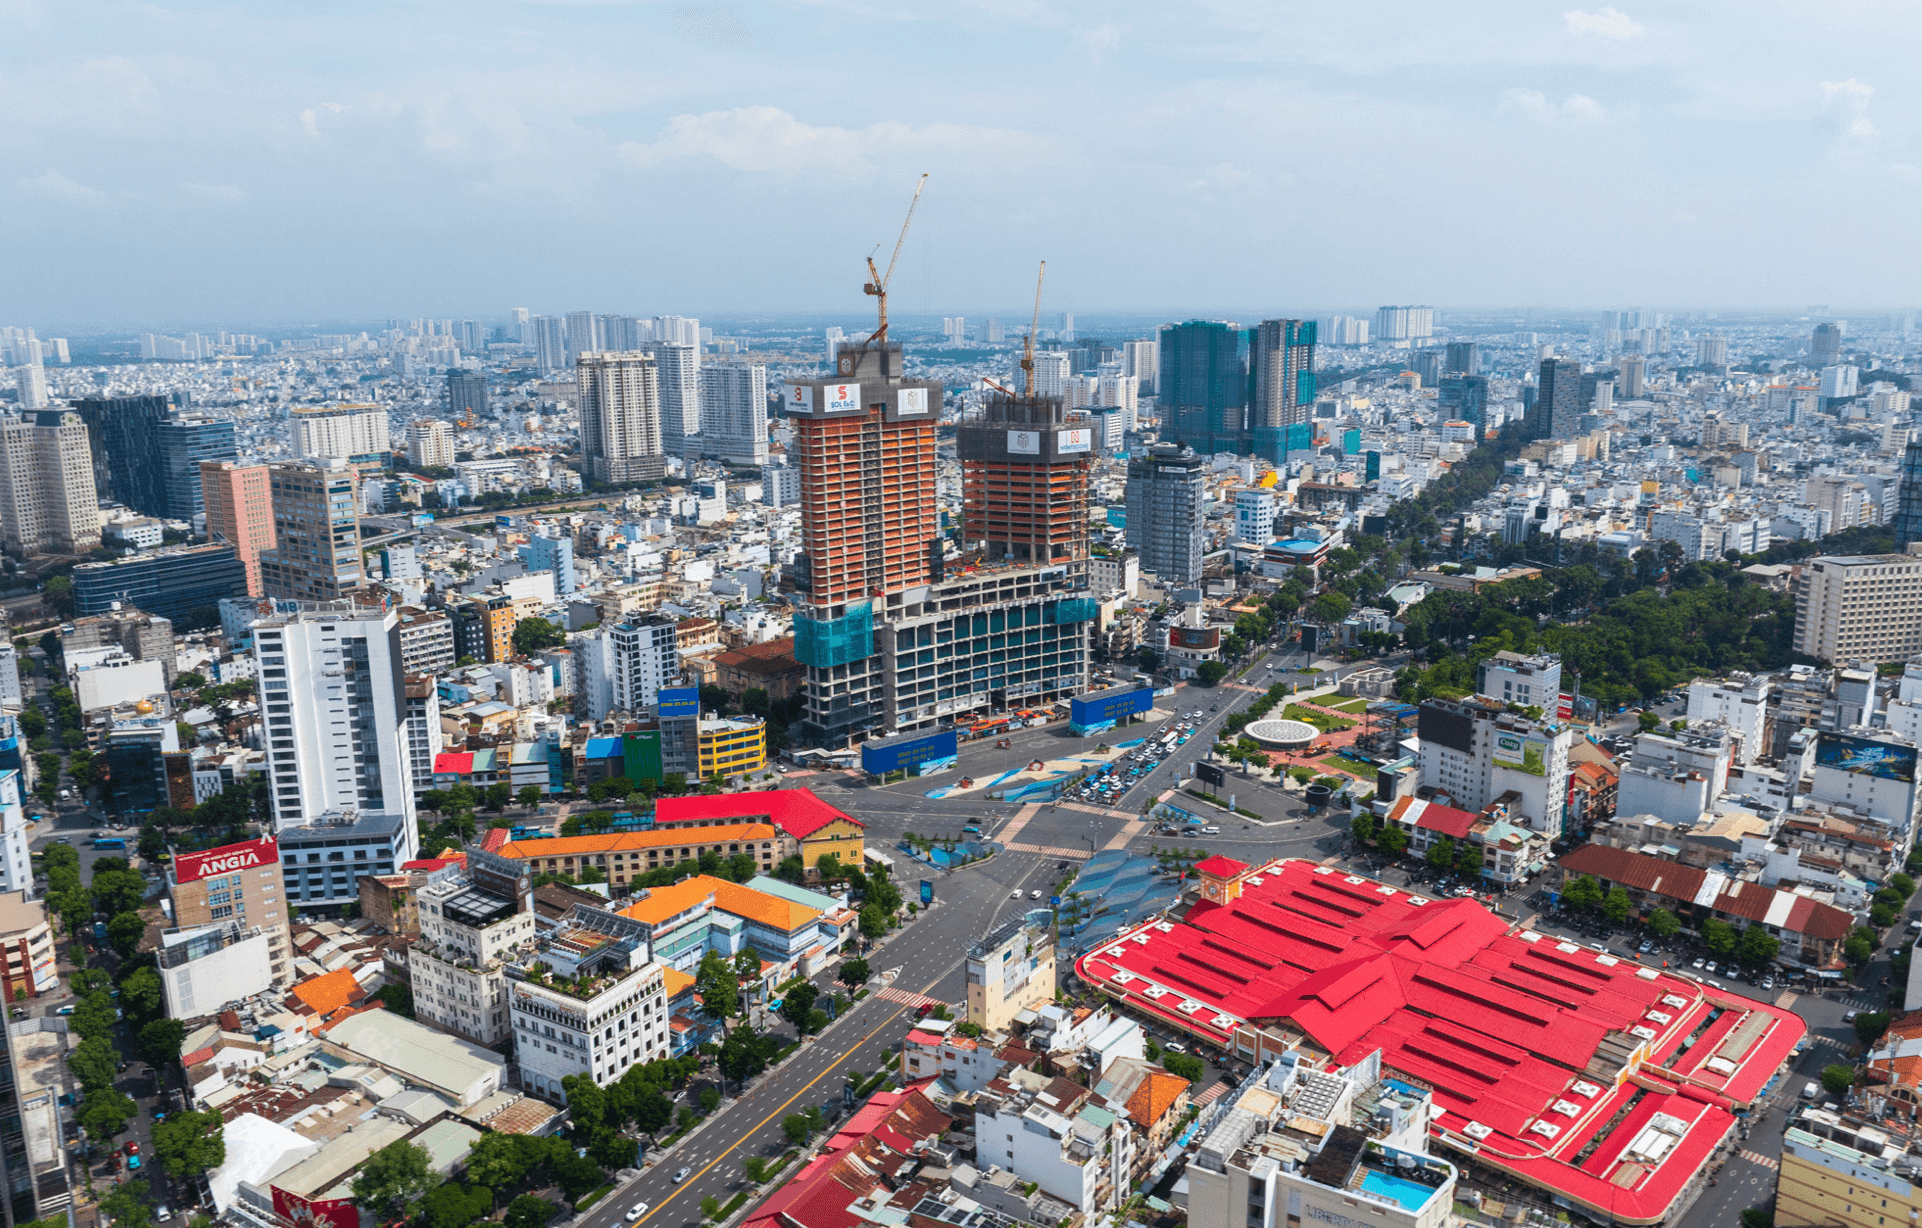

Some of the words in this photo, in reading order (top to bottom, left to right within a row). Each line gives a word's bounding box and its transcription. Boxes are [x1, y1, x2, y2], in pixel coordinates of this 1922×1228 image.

[276, 602, 298, 612] MB
[1500, 739, 1519, 749] Cozy
[1306, 1204, 1355, 1228] LIBERTY
